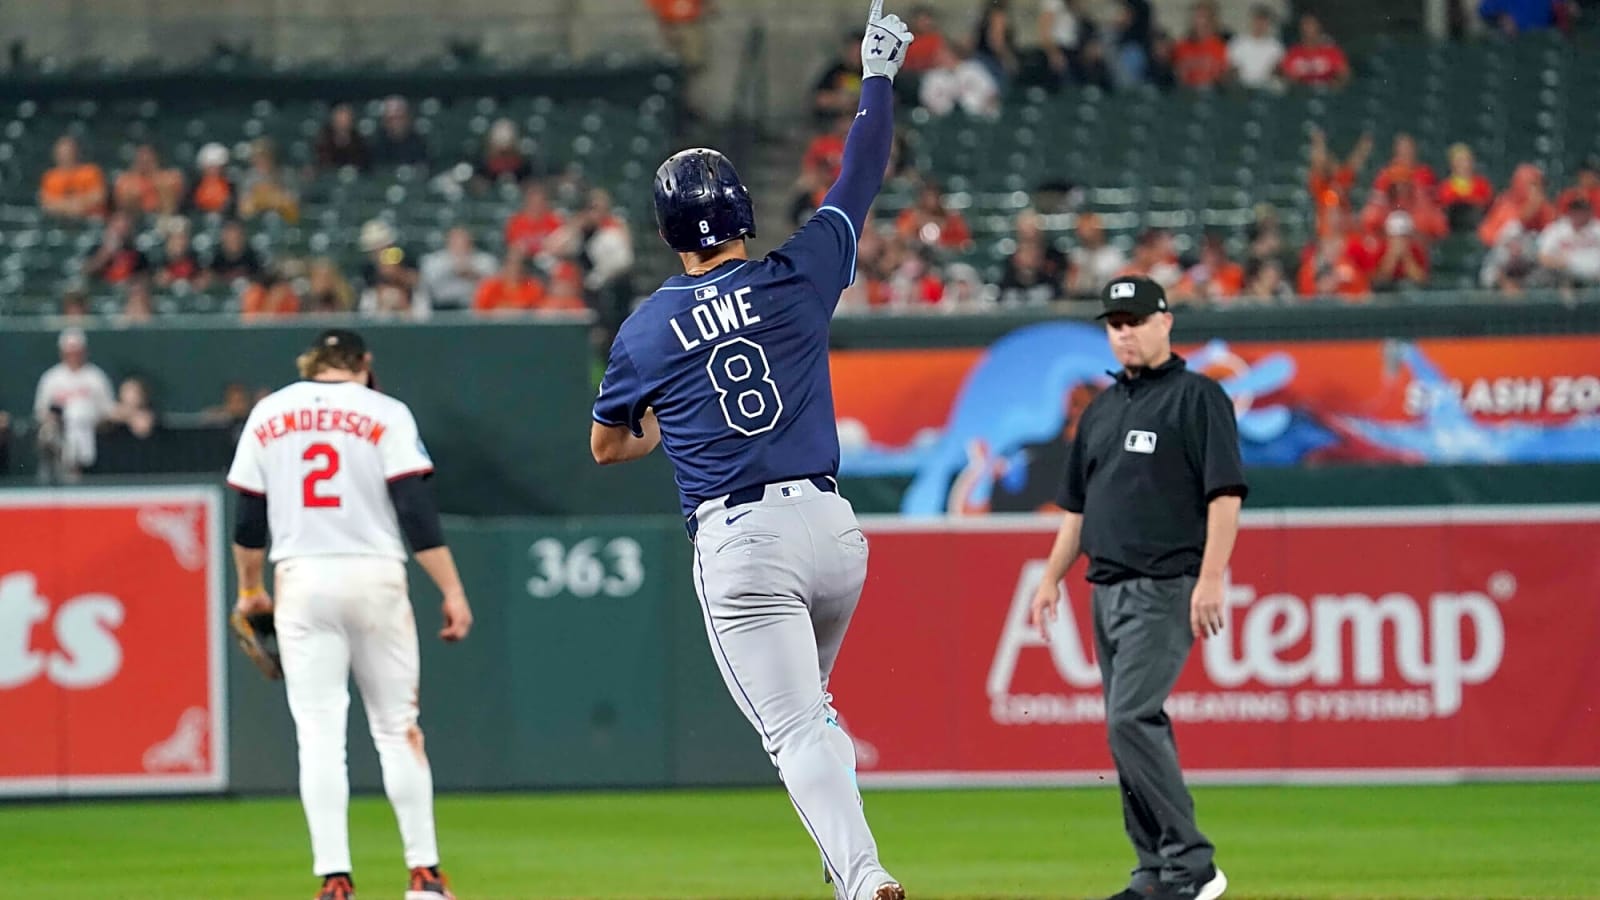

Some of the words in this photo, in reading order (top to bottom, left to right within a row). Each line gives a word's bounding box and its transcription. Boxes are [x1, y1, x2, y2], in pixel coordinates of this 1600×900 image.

[699, 219, 710, 235] 8
[669, 286, 761, 352] LOWE
[706, 336, 784, 436] 8
[1404, 376, 1543, 416] SASH
[253, 408, 386, 447] HENDERSON
[302, 441, 341, 508] 2
[525, 536, 645, 598] 363
[986, 557, 1505, 717] Atemp
[989, 692, 1105, 725] COOLIN
[1294, 688, 1432, 721] SYSTEMS
